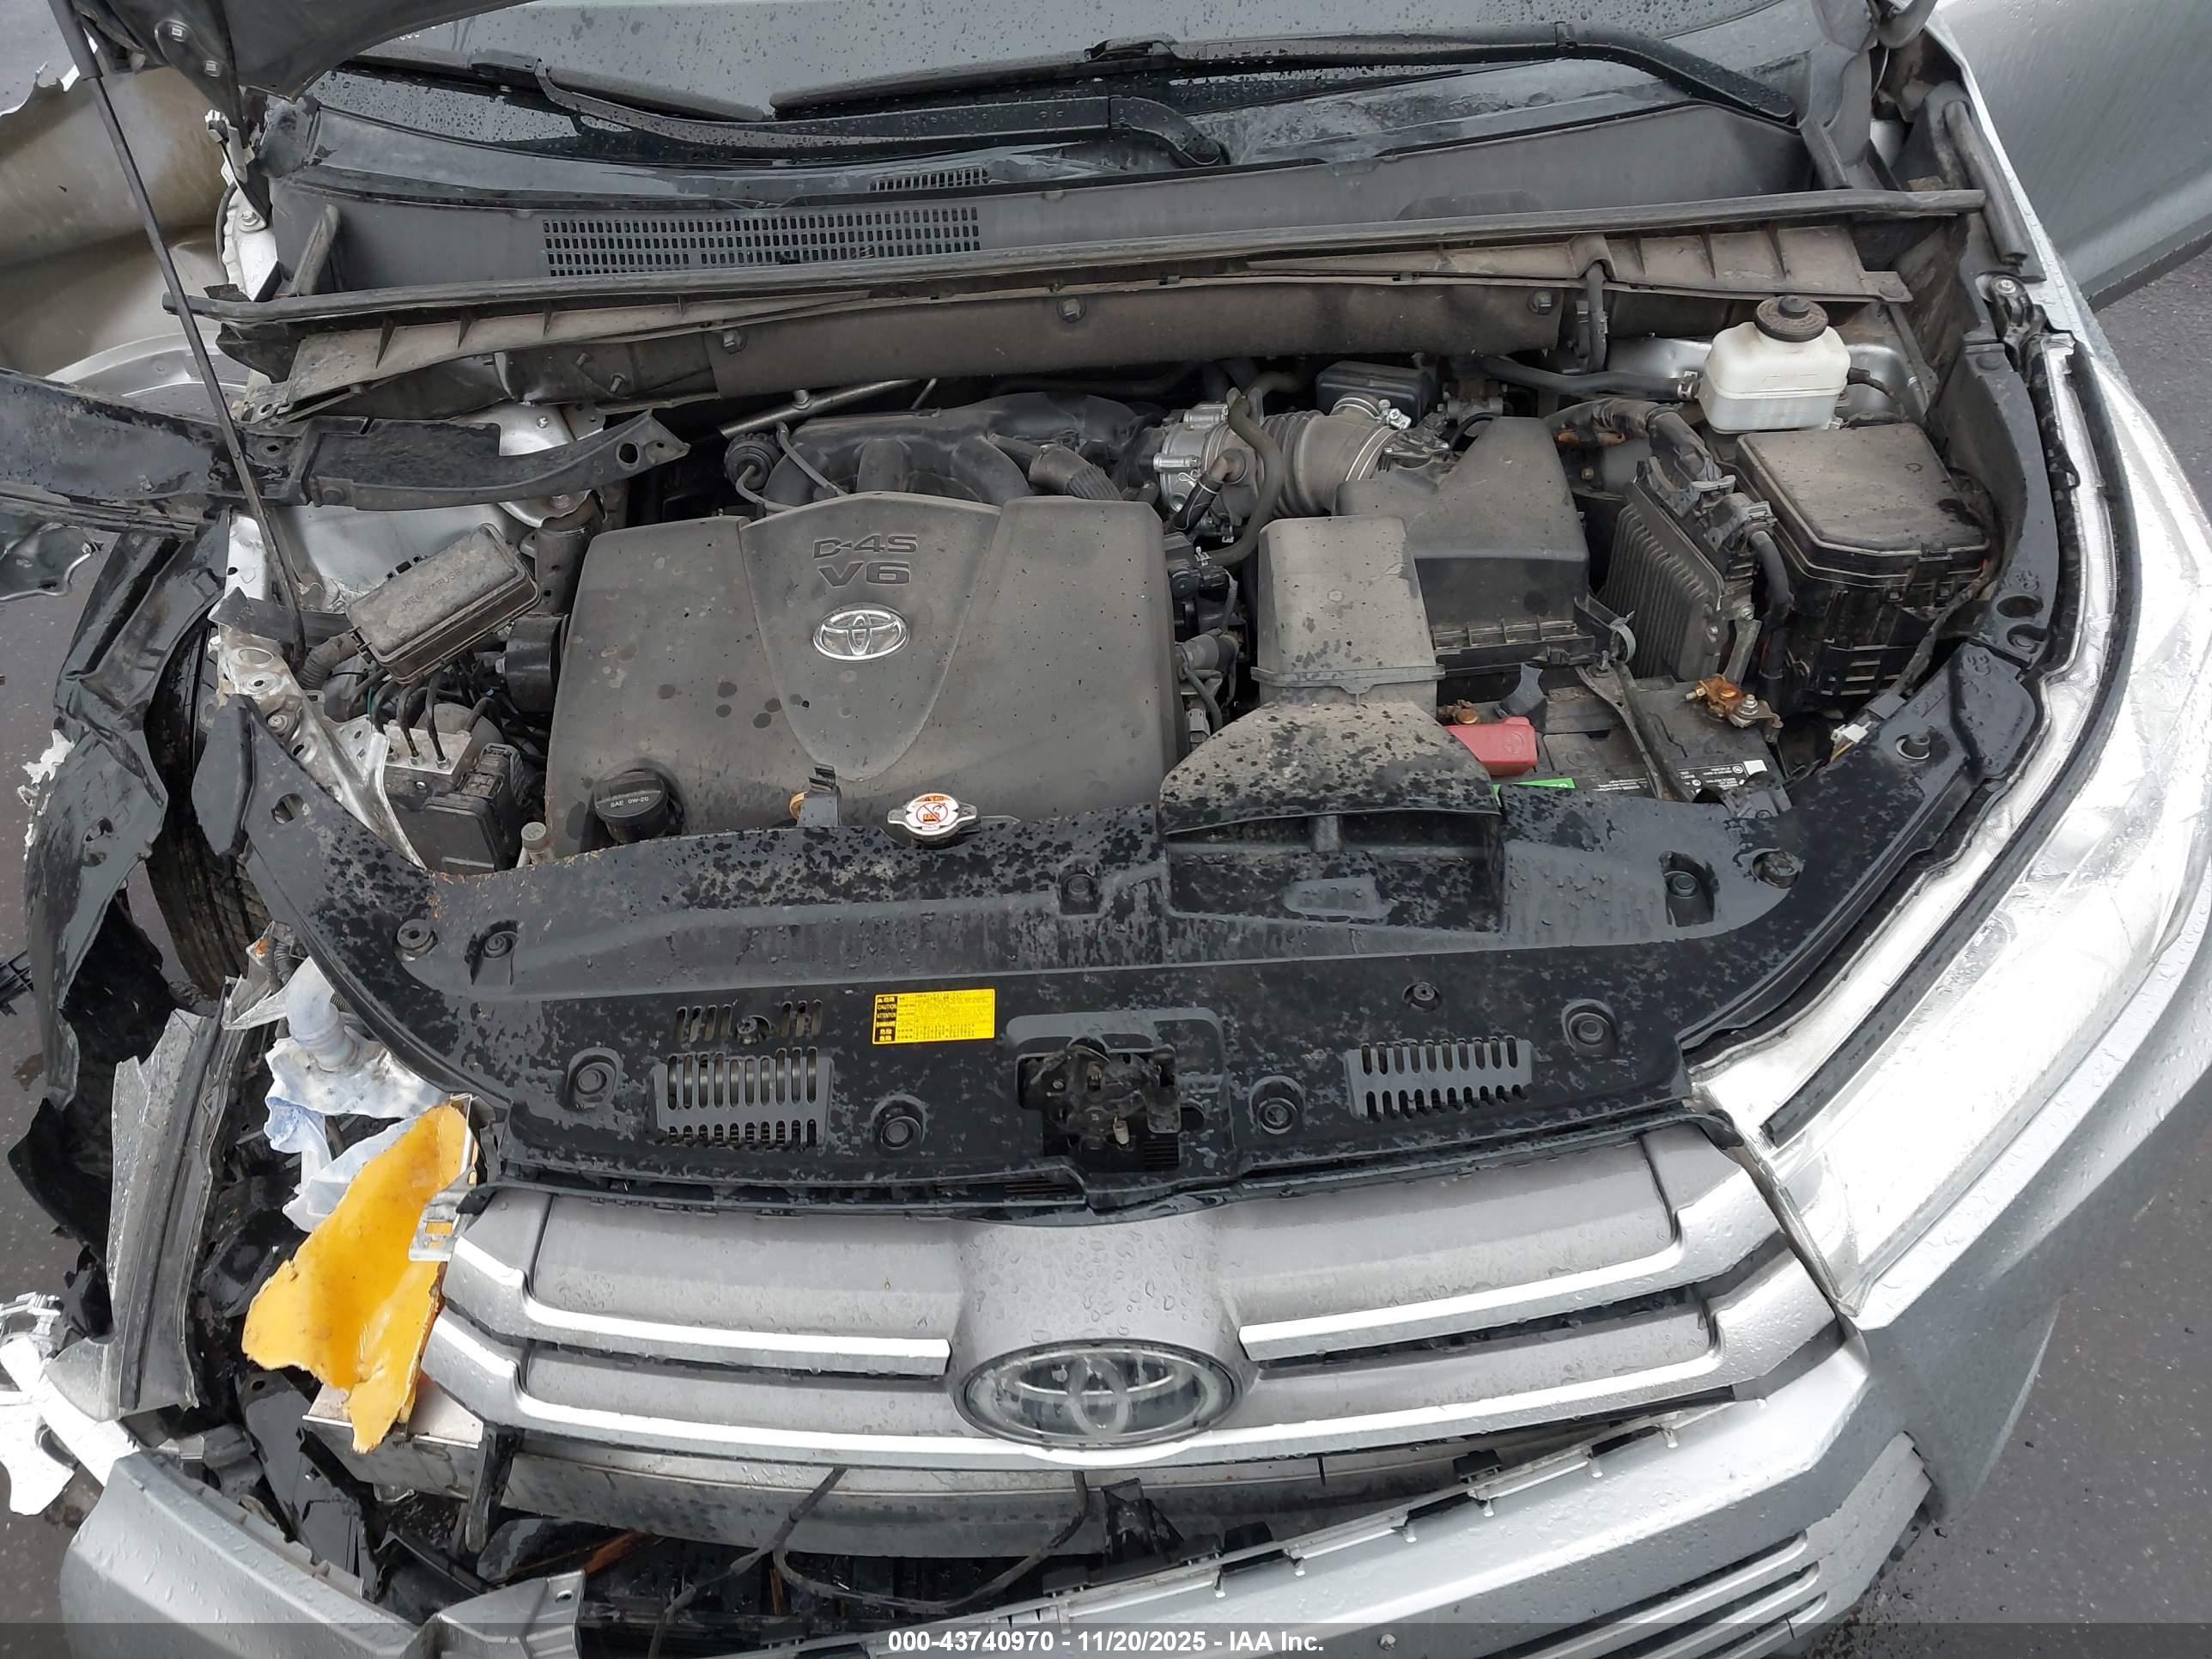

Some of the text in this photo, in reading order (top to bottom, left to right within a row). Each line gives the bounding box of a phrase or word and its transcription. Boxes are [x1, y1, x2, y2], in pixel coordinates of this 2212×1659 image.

[813, 533, 917, 559] D-4S
[817, 562, 910, 588] V6
[628, 796, 649, 805] 0W-20
